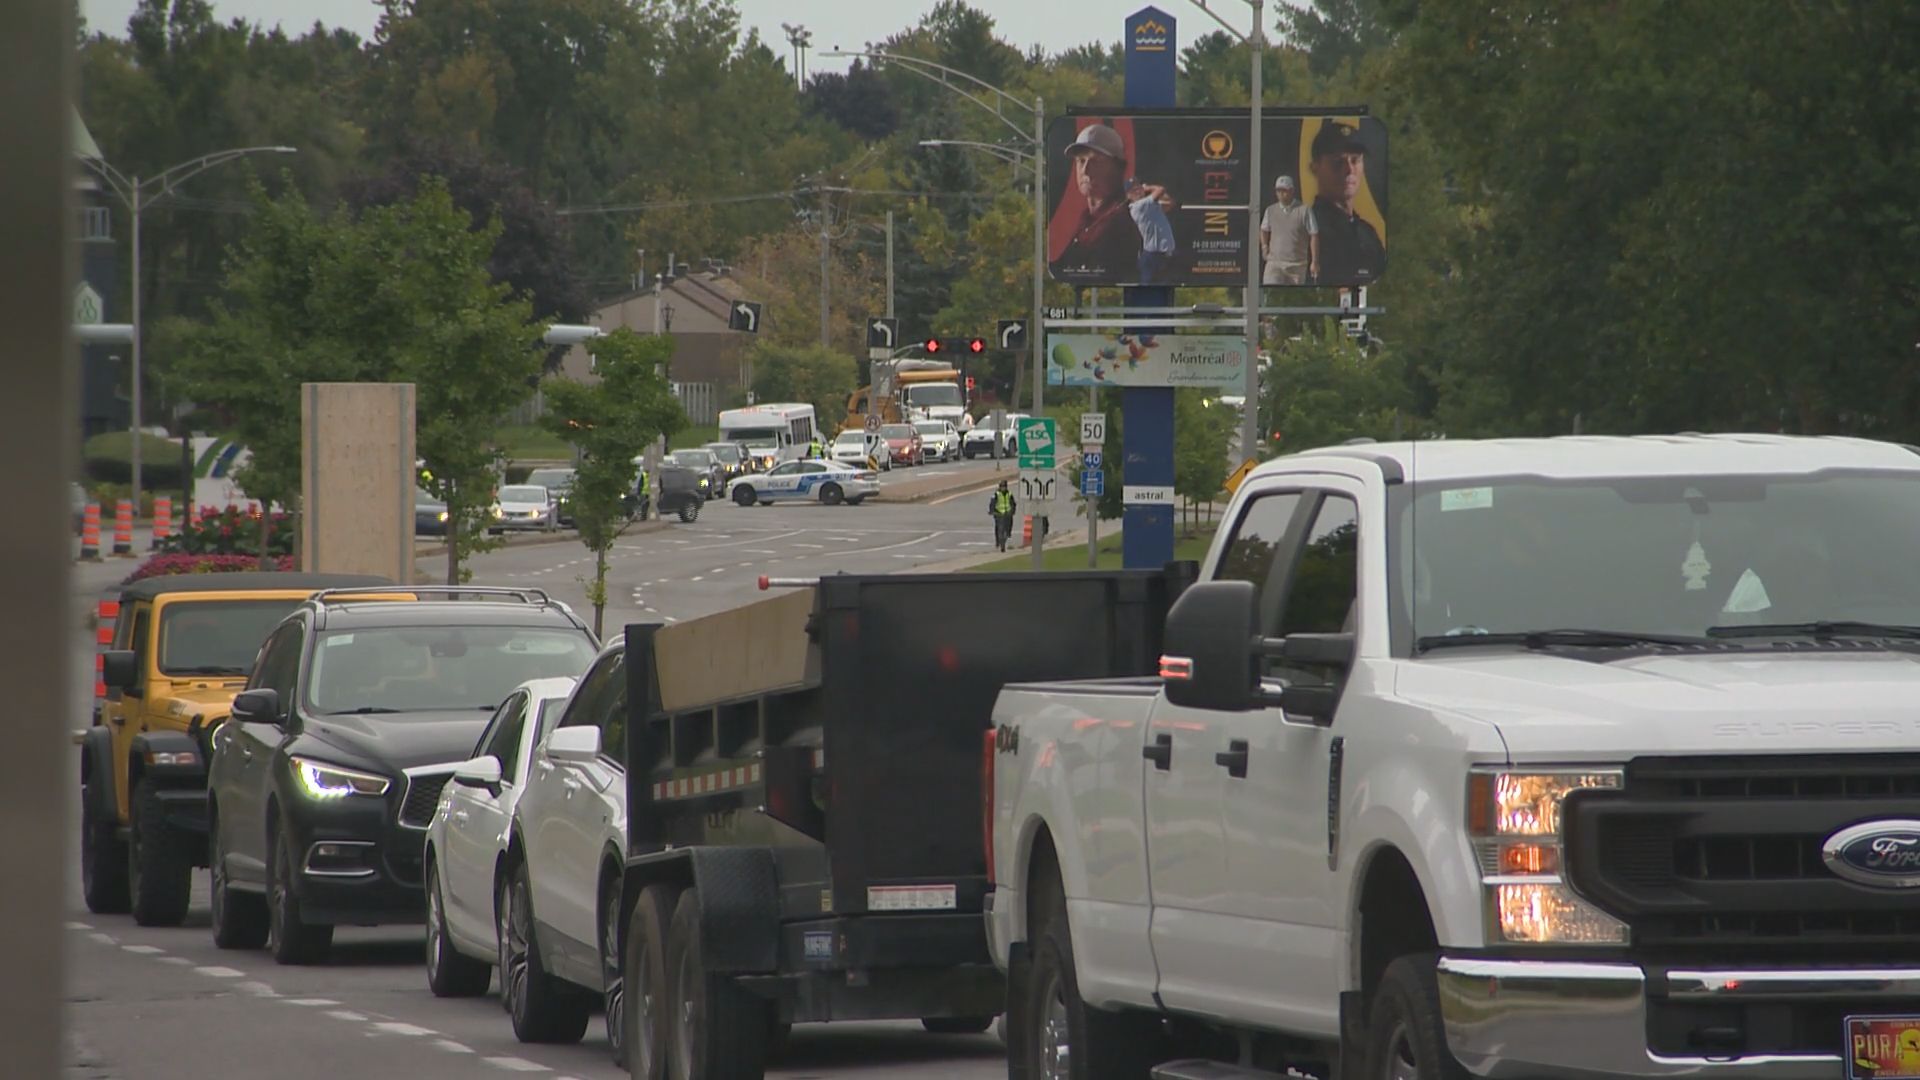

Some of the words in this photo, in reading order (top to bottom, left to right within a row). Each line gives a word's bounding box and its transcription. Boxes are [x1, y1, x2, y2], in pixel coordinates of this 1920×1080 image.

[1050, 308, 1065, 319] 681
[1170, 352, 1225, 365] Montréal
[1084, 423, 1102, 440] 50
[1085, 454, 1100, 465] 40
[767, 480, 790, 488] POLICE
[1134, 491, 1164, 500] astral
